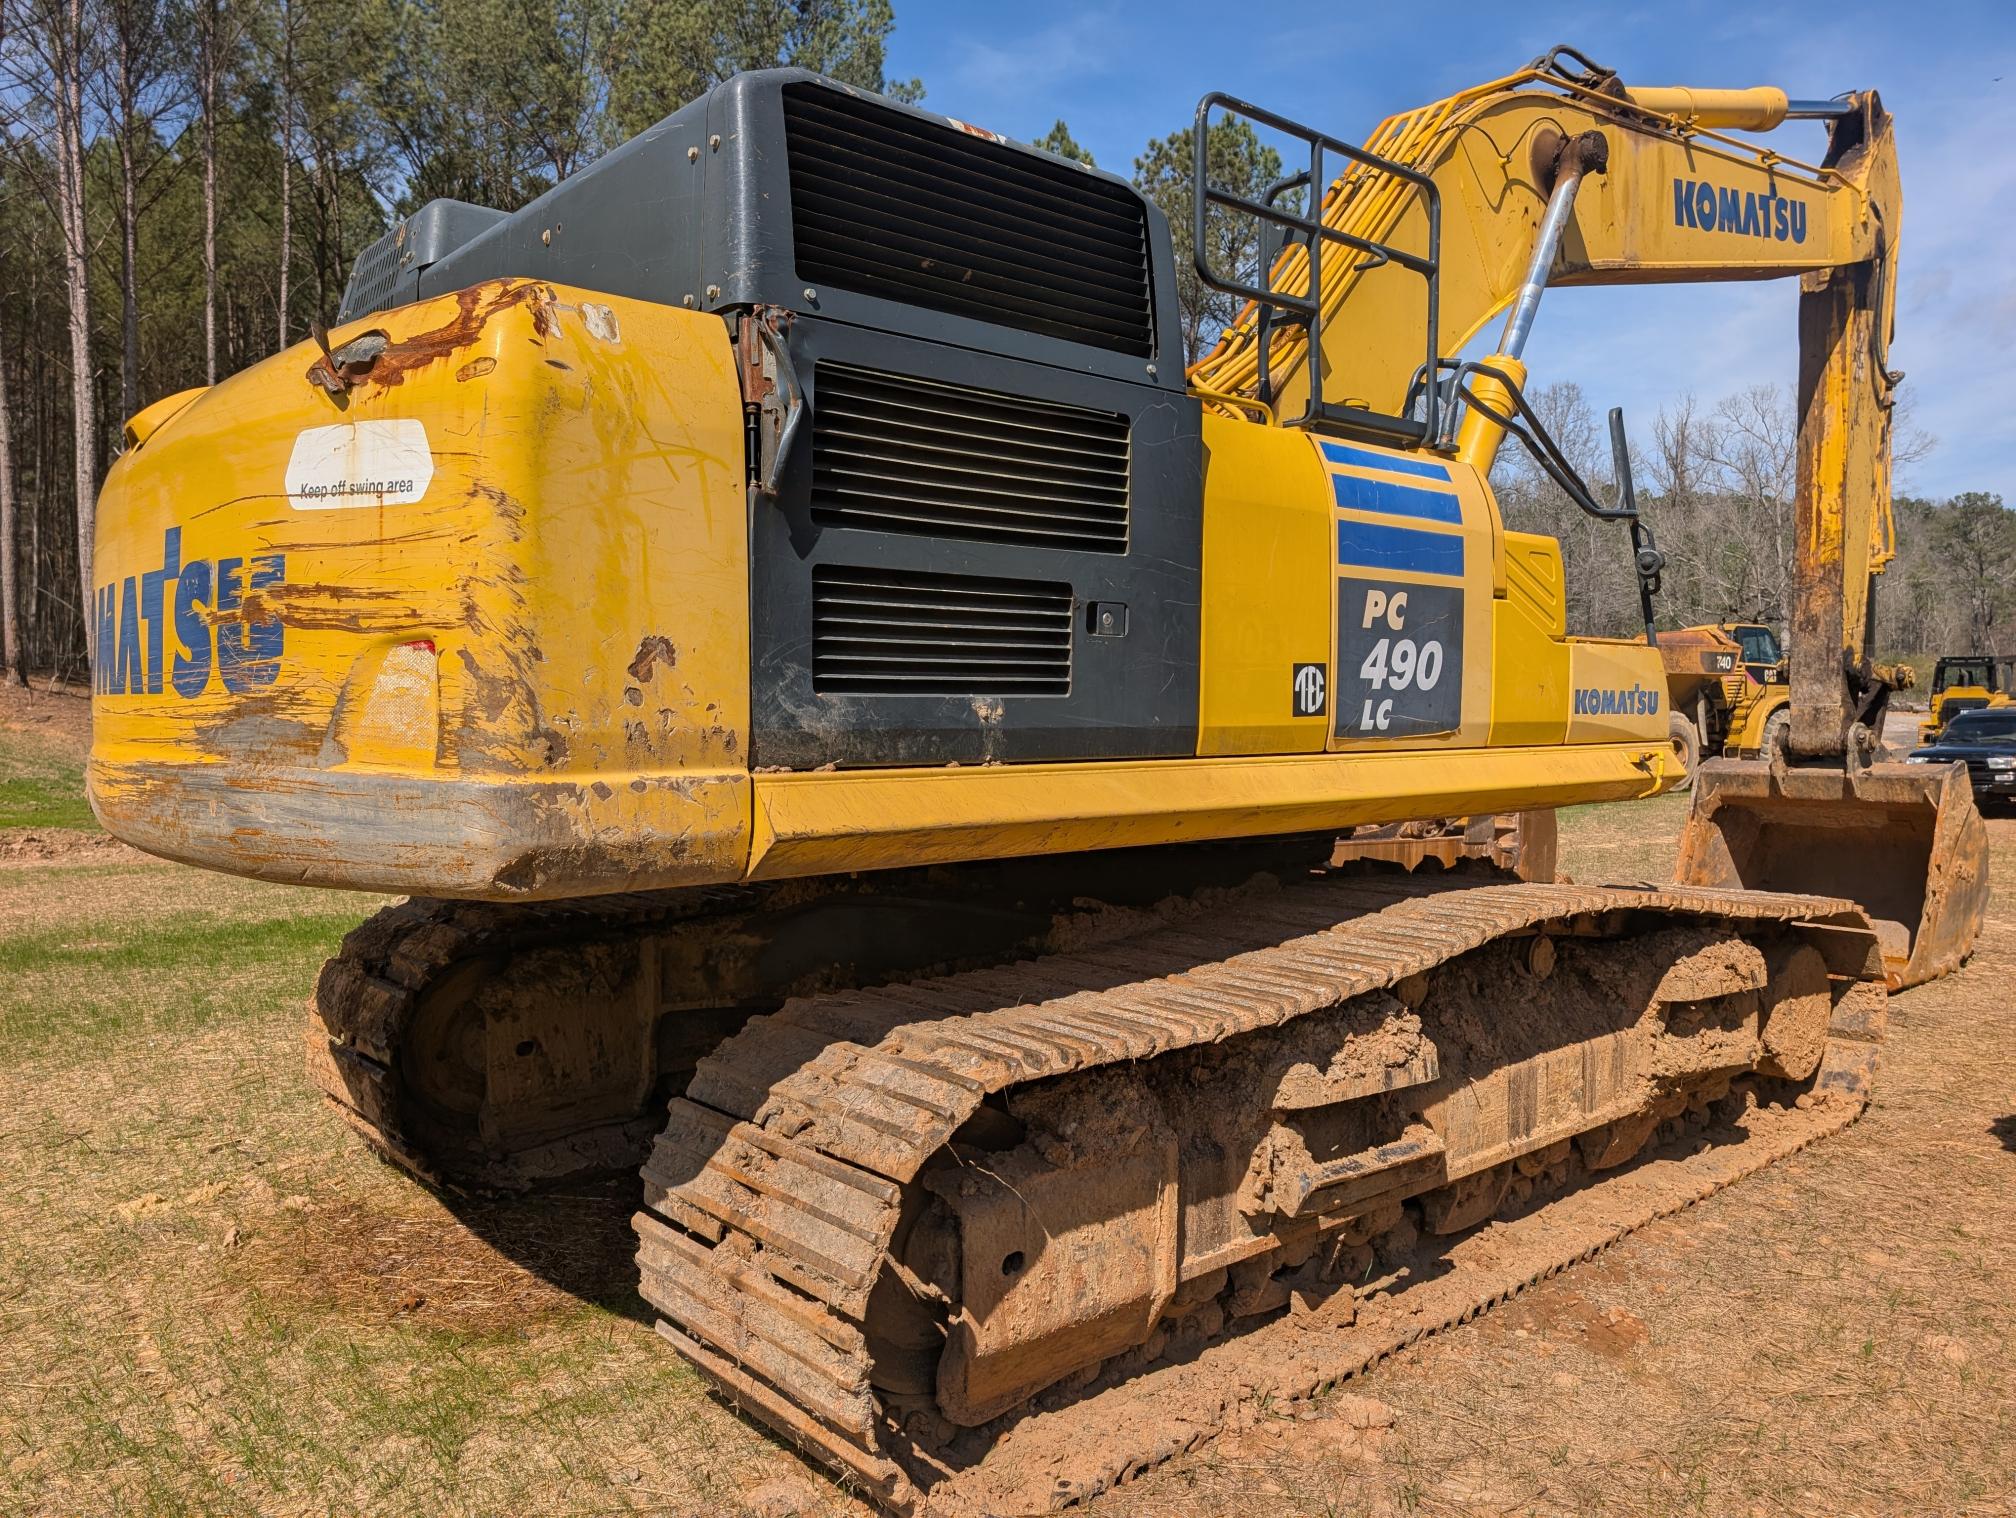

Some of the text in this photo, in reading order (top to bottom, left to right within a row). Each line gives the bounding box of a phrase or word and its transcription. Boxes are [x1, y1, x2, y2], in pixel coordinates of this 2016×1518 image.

[1673, 178, 1807, 245] KOMATSU
[300, 478, 413, 502] Keep off swing area
[93, 526, 286, 700] MATSU
[1362, 589, 1408, 631] PC
[1360, 638, 1443, 691] 490
[1716, 655, 1732, 670] 740
[1764, 669, 1777, 683] CAT
[1360, 699, 1393, 731] LC
[1574, 683, 1659, 716] KOMATSU
